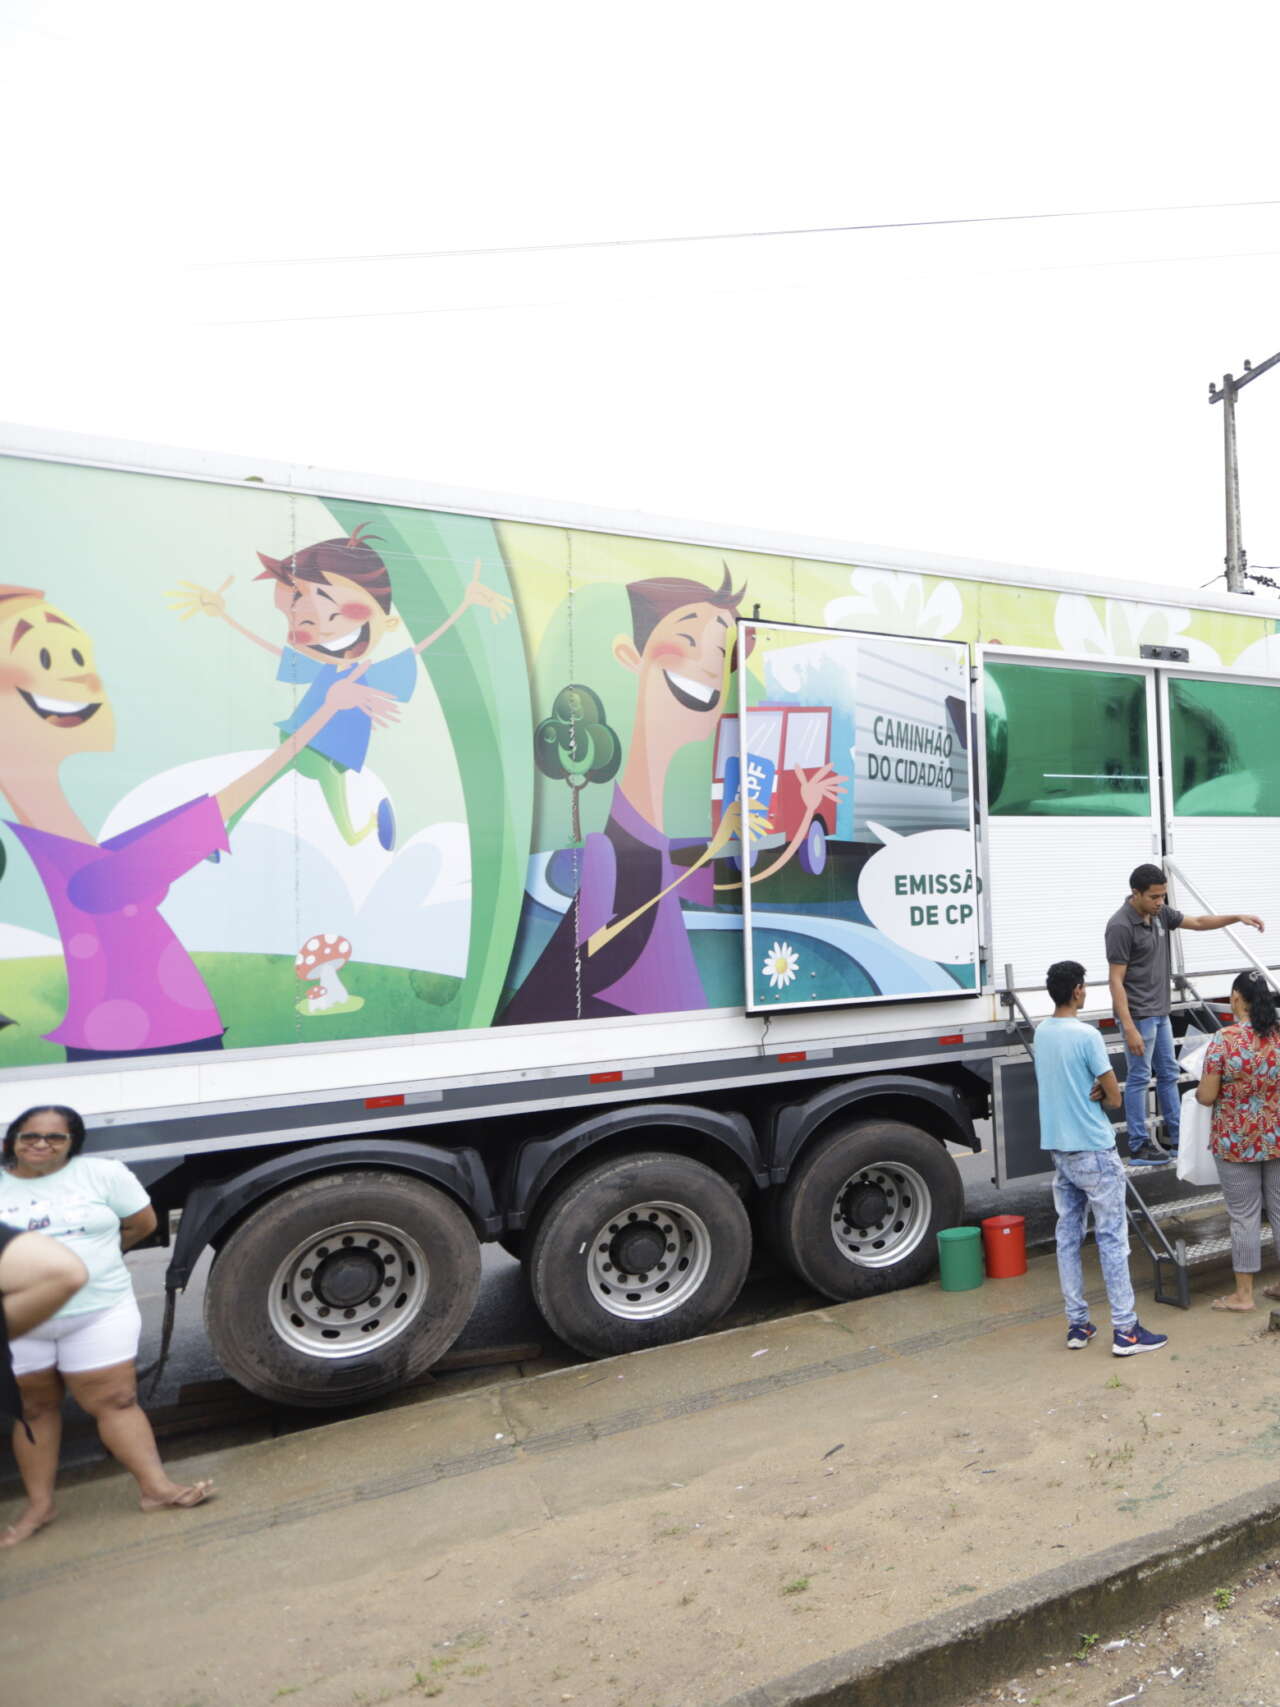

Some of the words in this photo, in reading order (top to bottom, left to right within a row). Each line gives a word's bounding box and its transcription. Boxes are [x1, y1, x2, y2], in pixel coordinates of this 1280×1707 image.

[874, 715, 953, 758] CAMINHÃO
[868, 753, 891, 781] DO
[895, 758, 953, 788] CIDADÃO
[910, 905, 939, 926] DE
